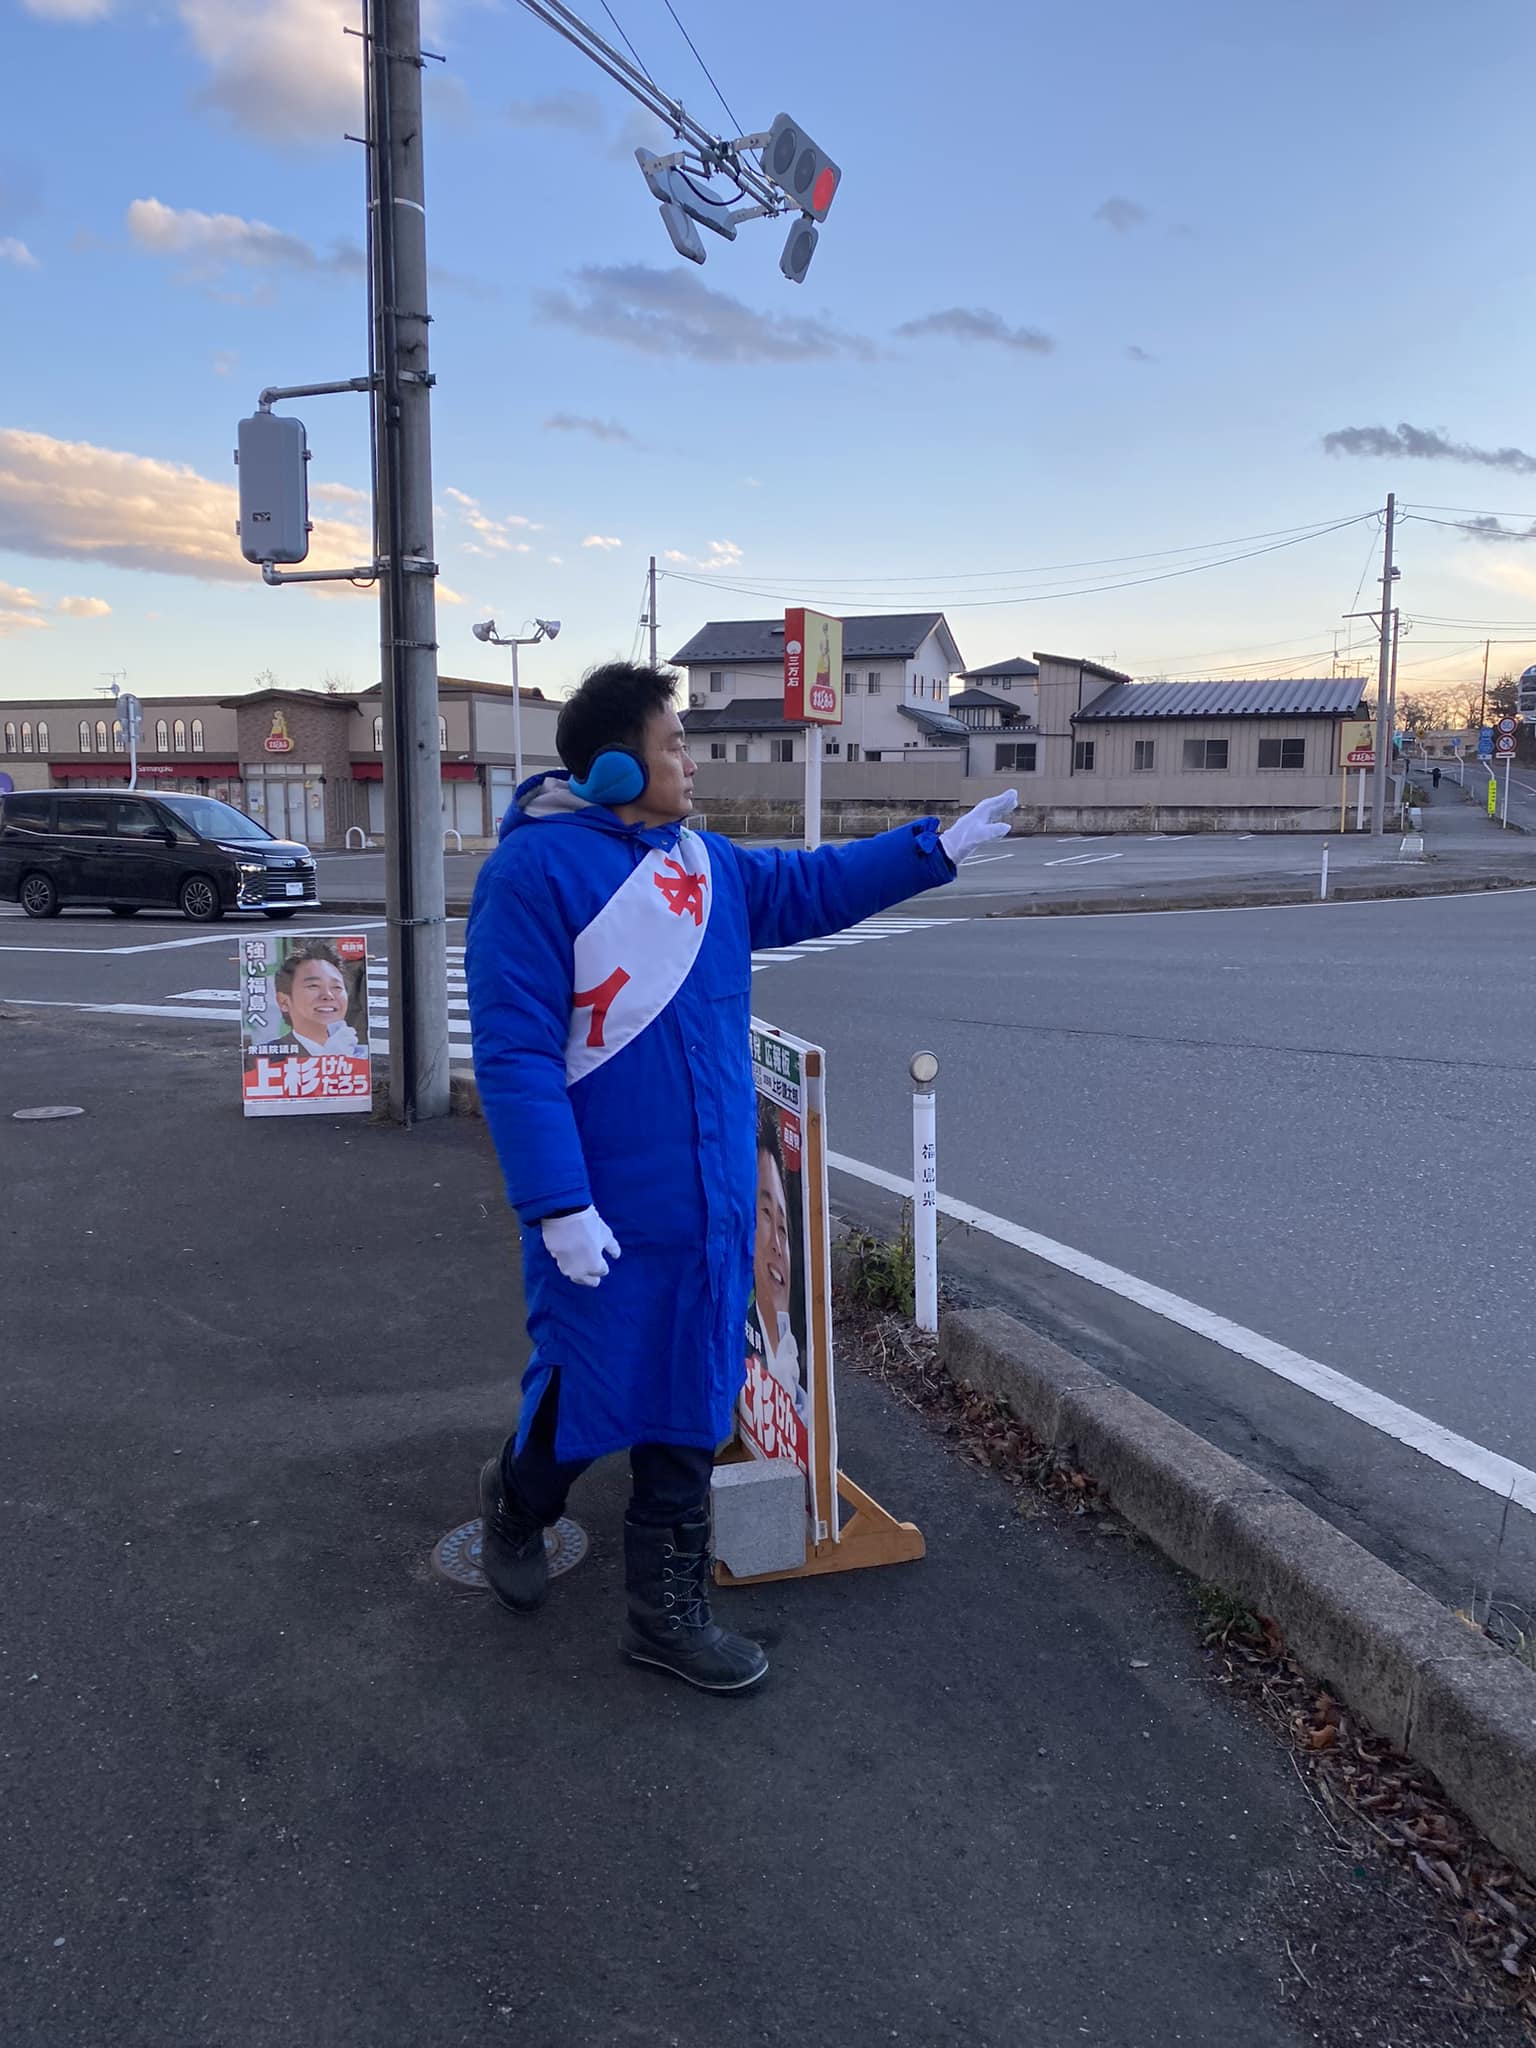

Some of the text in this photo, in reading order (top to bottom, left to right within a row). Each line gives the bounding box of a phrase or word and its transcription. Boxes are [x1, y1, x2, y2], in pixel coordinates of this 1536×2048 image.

[786, 655, 800, 688] 三万石
[246, 940, 268, 1028] 強い福島へ
[248, 1044, 299, 1055] 衆議院議員
[321, 1056, 353, 1075] けん
[246, 1056, 320, 1097] 上杉
[321, 1073, 368, 1095] たろう
[921, 1143, 936, 1207] 福島県
